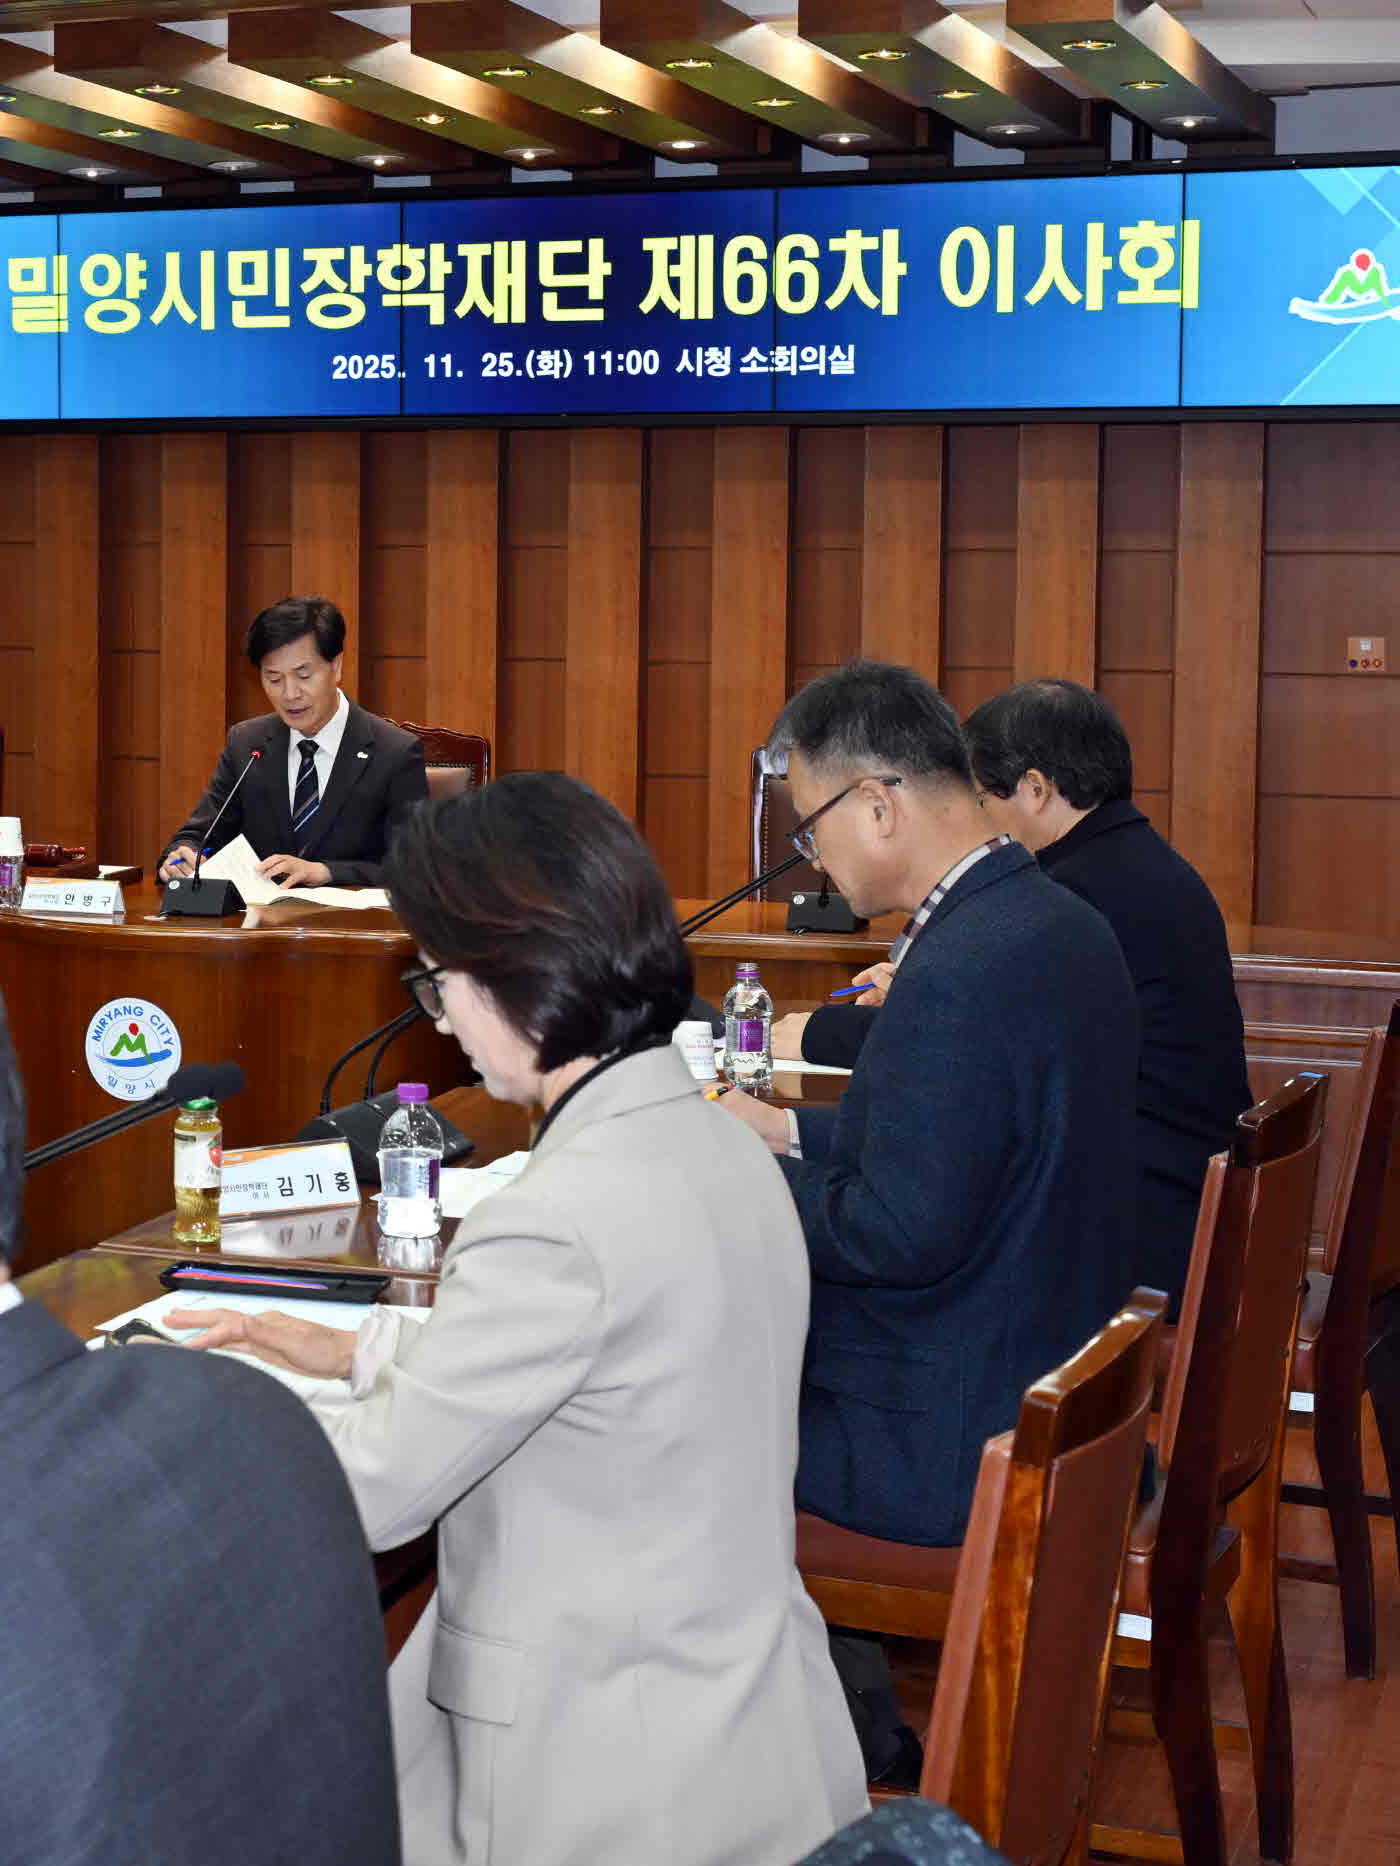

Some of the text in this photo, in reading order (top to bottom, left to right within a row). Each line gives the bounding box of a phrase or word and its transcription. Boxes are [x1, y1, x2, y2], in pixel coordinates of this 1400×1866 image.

[8, 219, 1200, 334] 밀양시민장학재단 제66차 이사회
[332, 344, 855, 380] 2025. 11. 25.(화) 11:00 시청 소회의실
[92, 1005, 174, 1046] MIRYANG CITY
